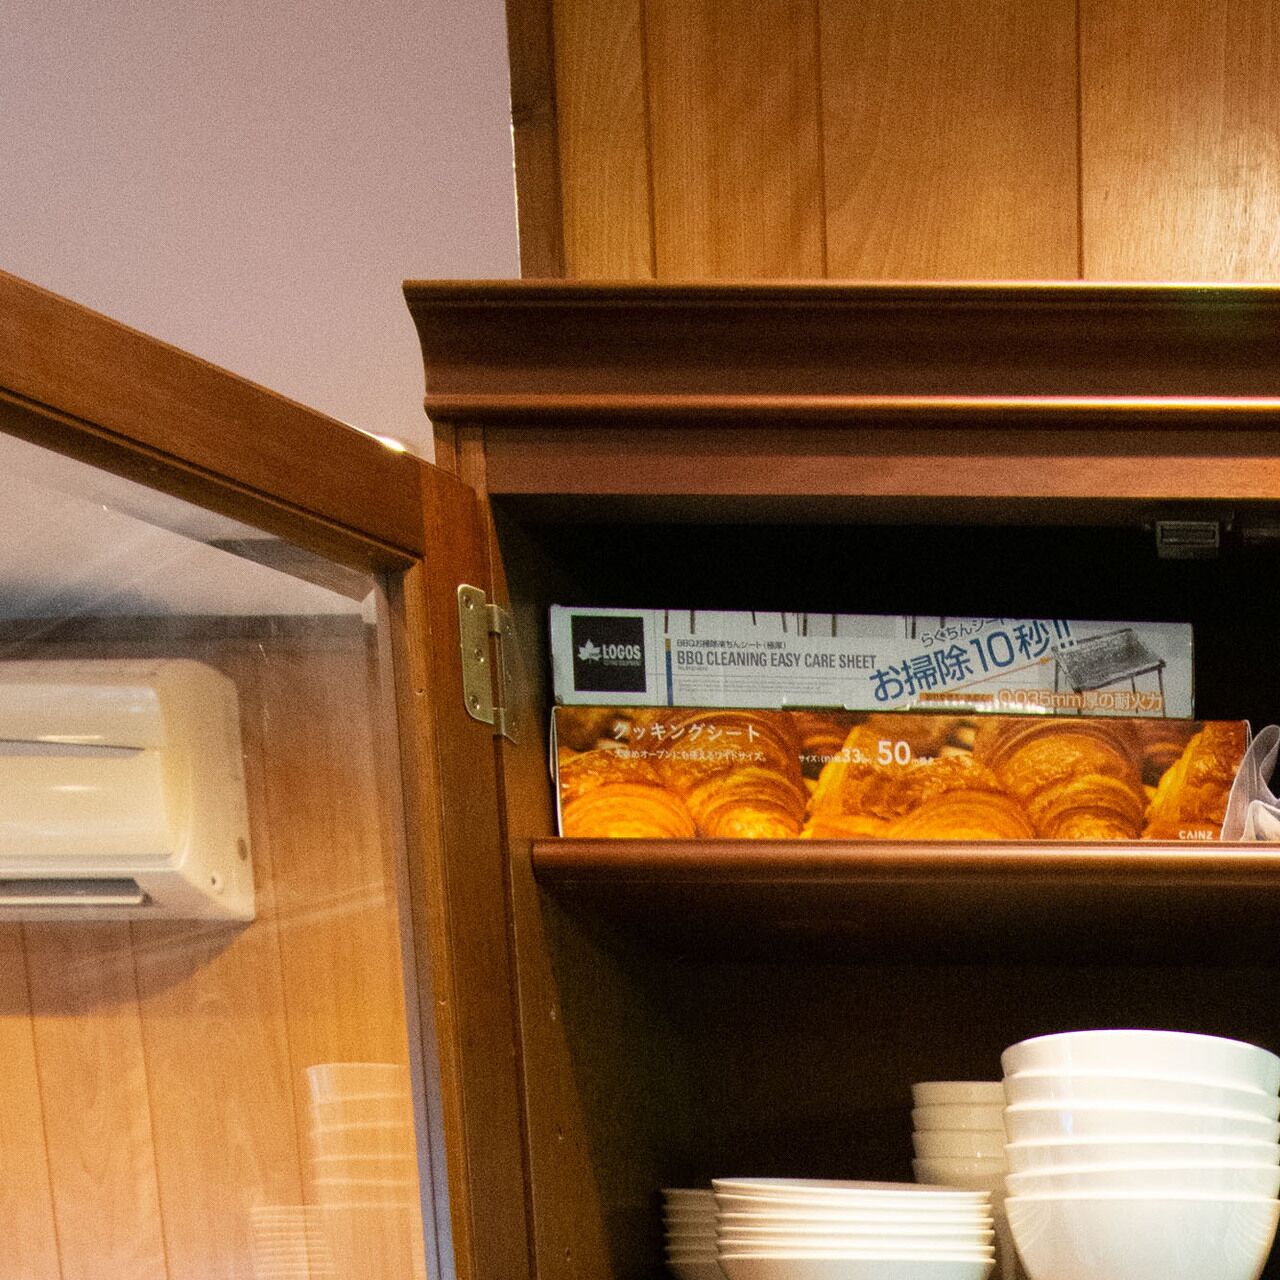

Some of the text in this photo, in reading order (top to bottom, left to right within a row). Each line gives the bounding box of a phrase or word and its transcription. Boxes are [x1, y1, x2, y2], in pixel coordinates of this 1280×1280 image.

[602, 643, 642, 660] LOGOS
[677, 650, 877, 670] BBQ CLEANING EASY CARE SHEET
[613, 721, 761, 743] クッキングシート
[1178, 830, 1214, 840] CAINZ
